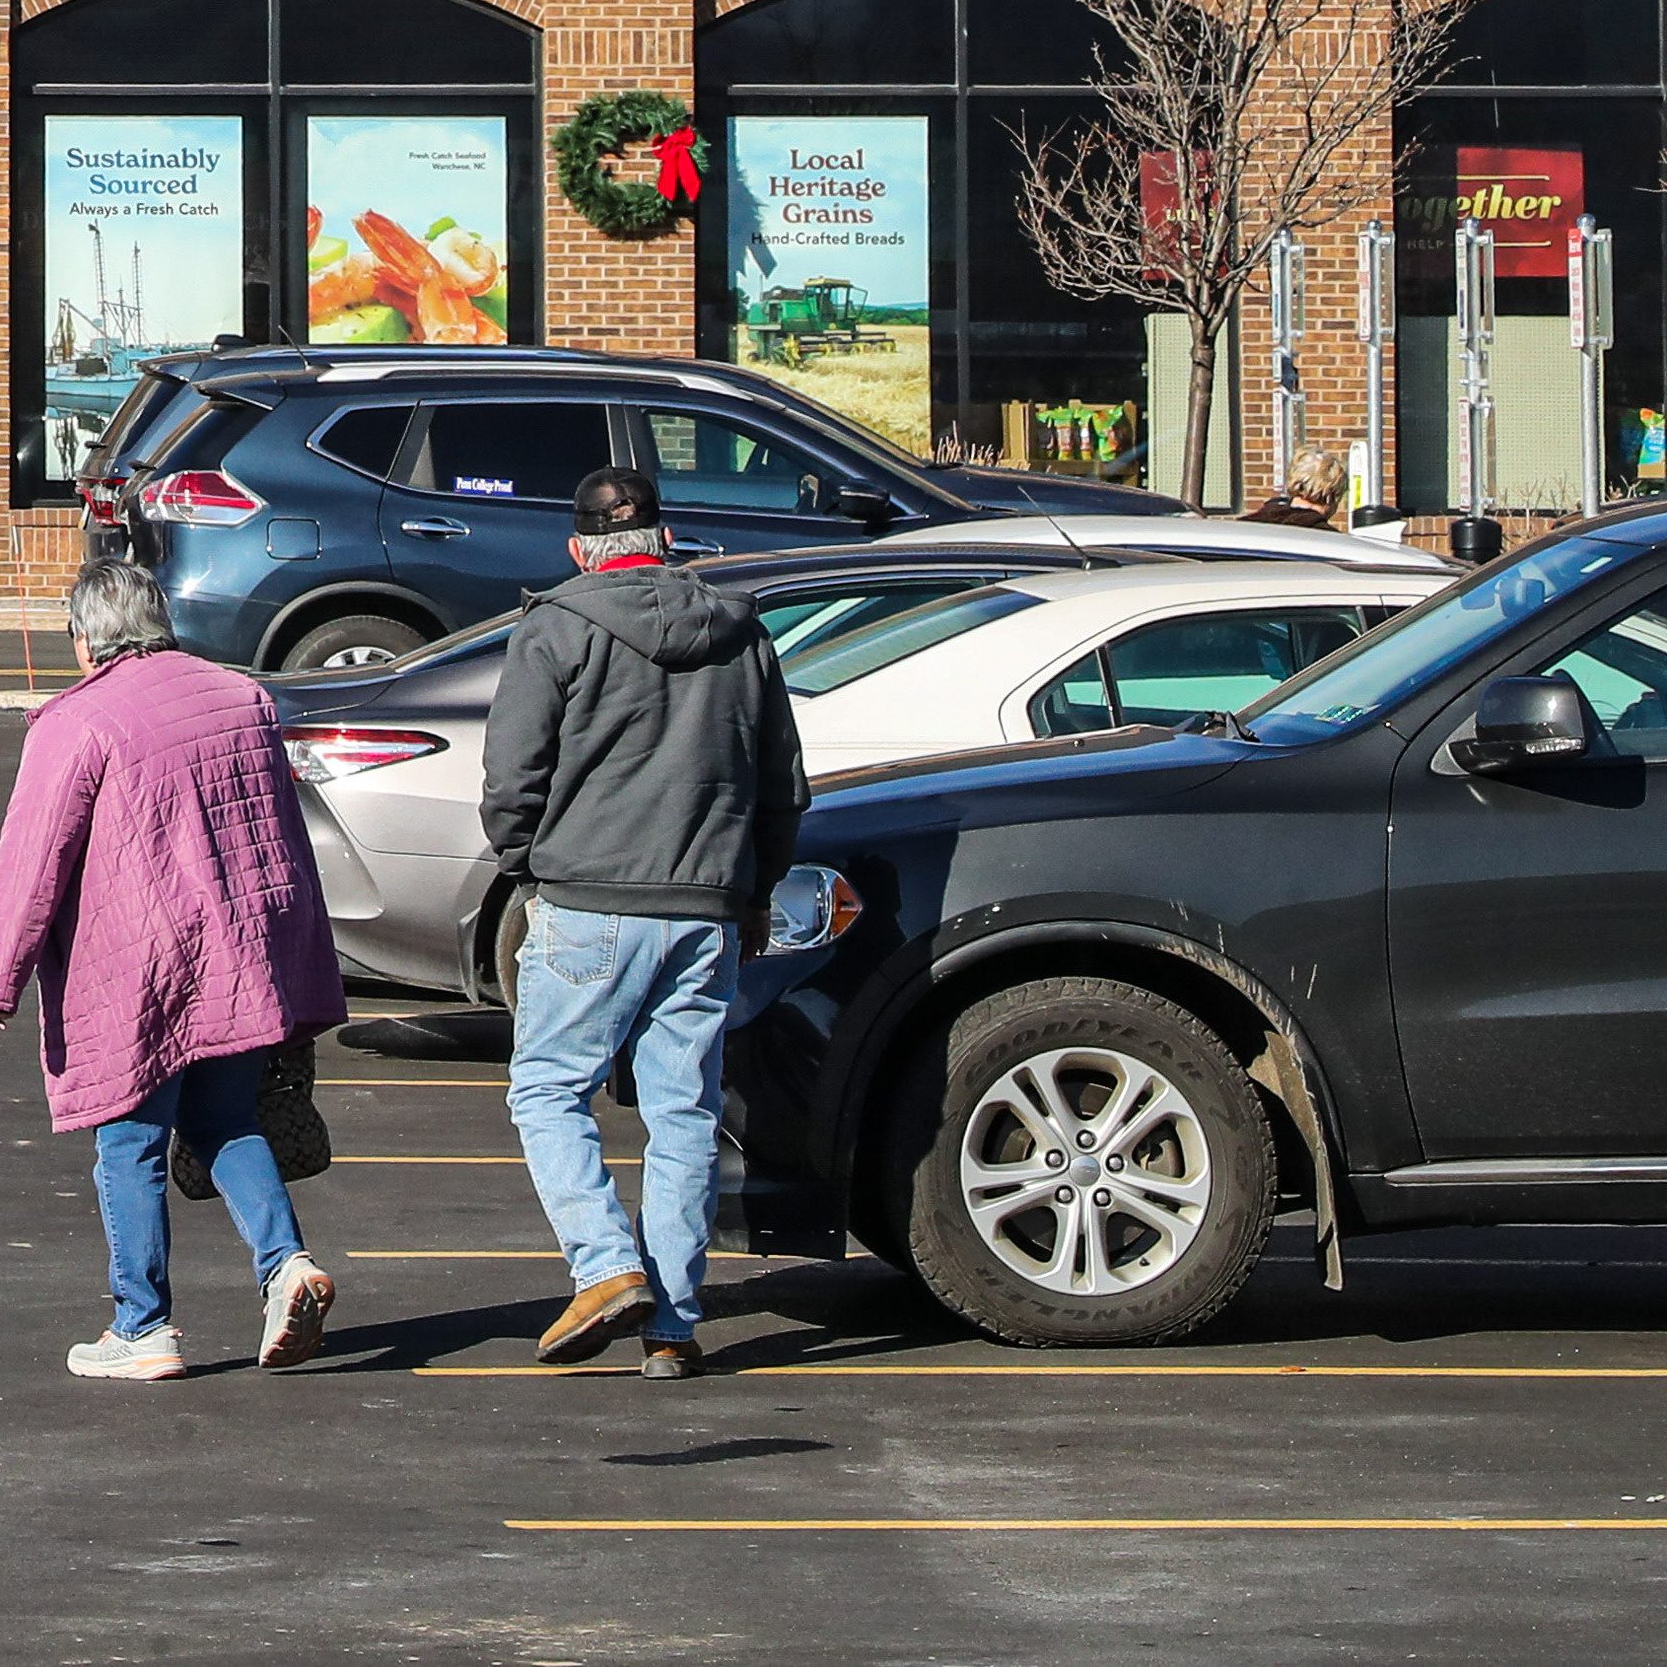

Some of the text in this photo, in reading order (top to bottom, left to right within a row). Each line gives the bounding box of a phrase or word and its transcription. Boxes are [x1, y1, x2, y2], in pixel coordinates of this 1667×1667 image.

[66, 147, 221, 173] Sustainably
[790, 148, 865, 170] Local
[89, 174, 198, 195] Sourced
[769, 176, 887, 202] Heritage
[69, 202, 219, 219] Always a Fresh Catch
[782, 202, 874, 224] Grains
[1399, 183, 1562, 232] ogether
[751, 231, 905, 245] Hand-Crafted Breads
